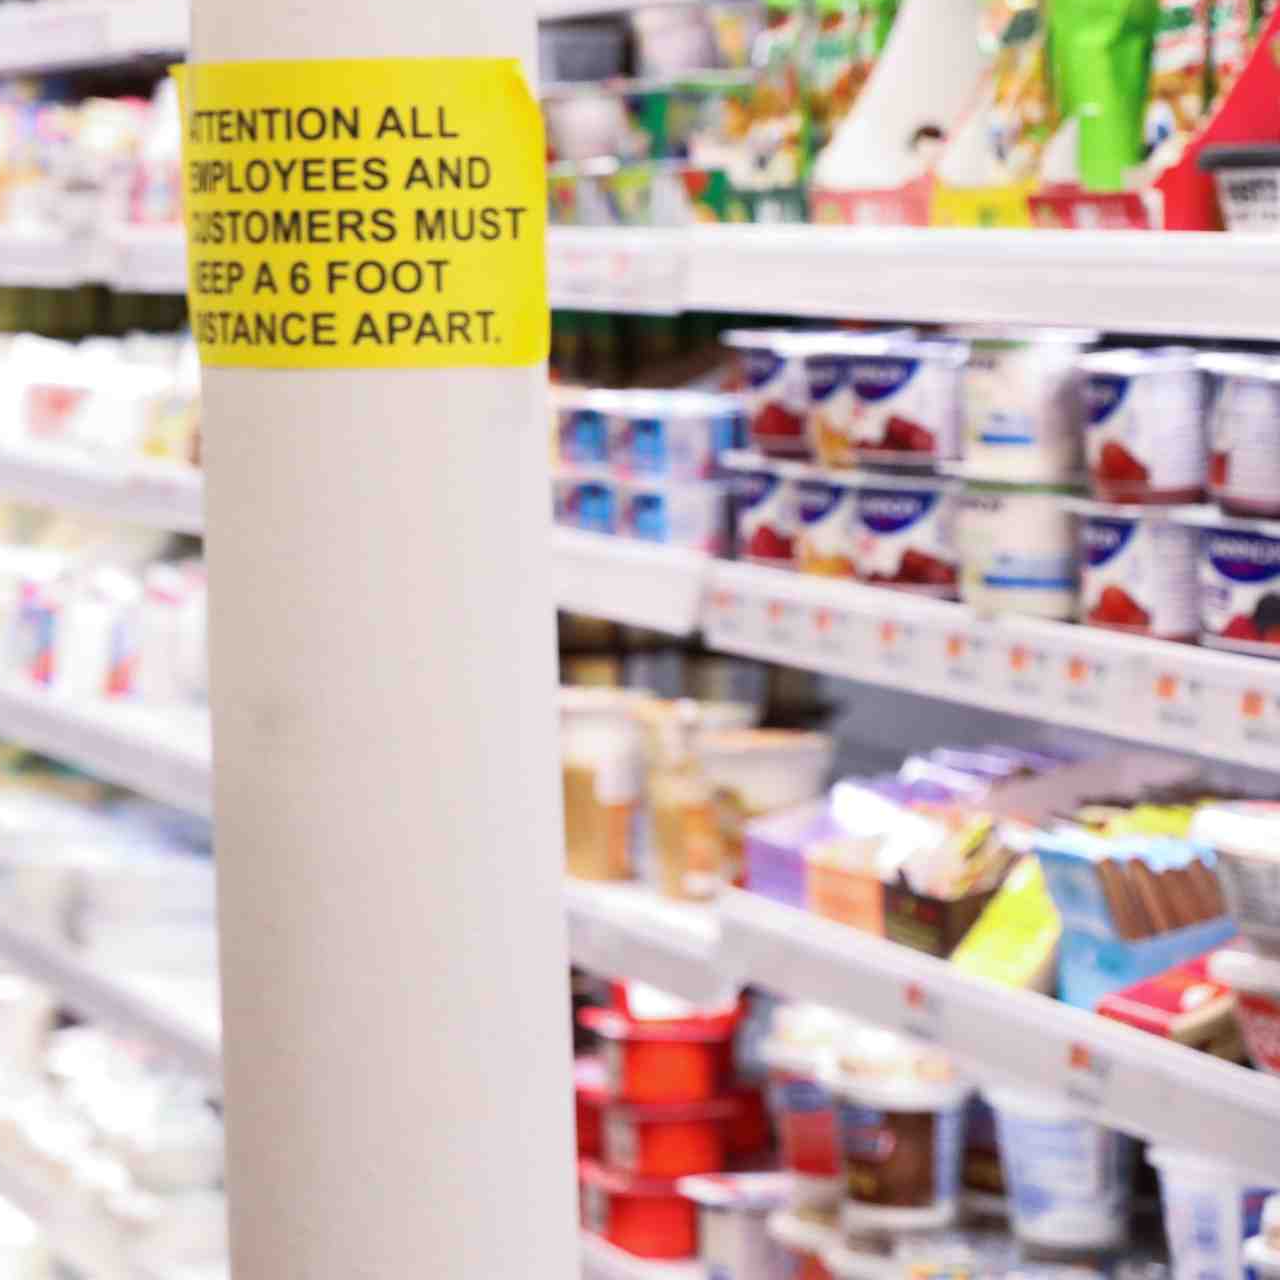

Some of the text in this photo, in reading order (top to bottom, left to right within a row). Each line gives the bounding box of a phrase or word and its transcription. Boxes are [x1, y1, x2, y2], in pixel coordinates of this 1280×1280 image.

[376, 107, 459, 140] ALL
[404, 157, 491, 190] AND
[194, 207, 527, 245] USTOMERS MUST
[196, 260, 450, 295] EEP A 6 FOOT
[197, 310, 502, 346] ISTANCE APART.
